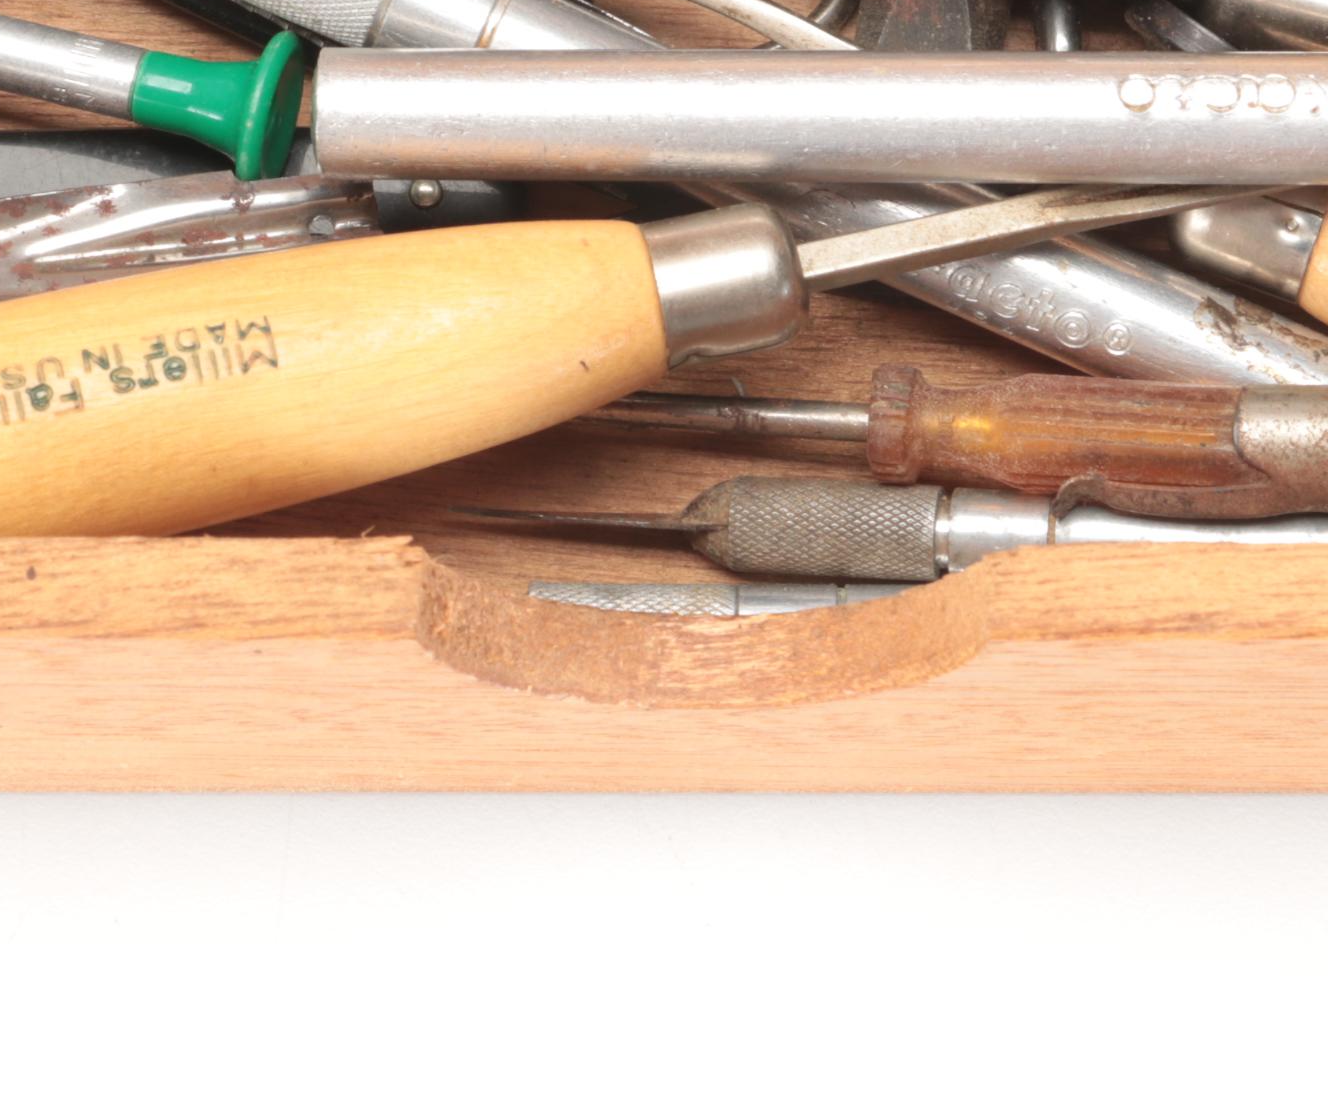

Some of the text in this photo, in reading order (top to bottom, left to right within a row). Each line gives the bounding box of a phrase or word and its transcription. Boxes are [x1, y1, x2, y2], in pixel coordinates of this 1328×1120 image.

[81, 342, 126, 373] IN
[139, 314, 273, 360] MADE
[108, 342, 279, 394] Millers
